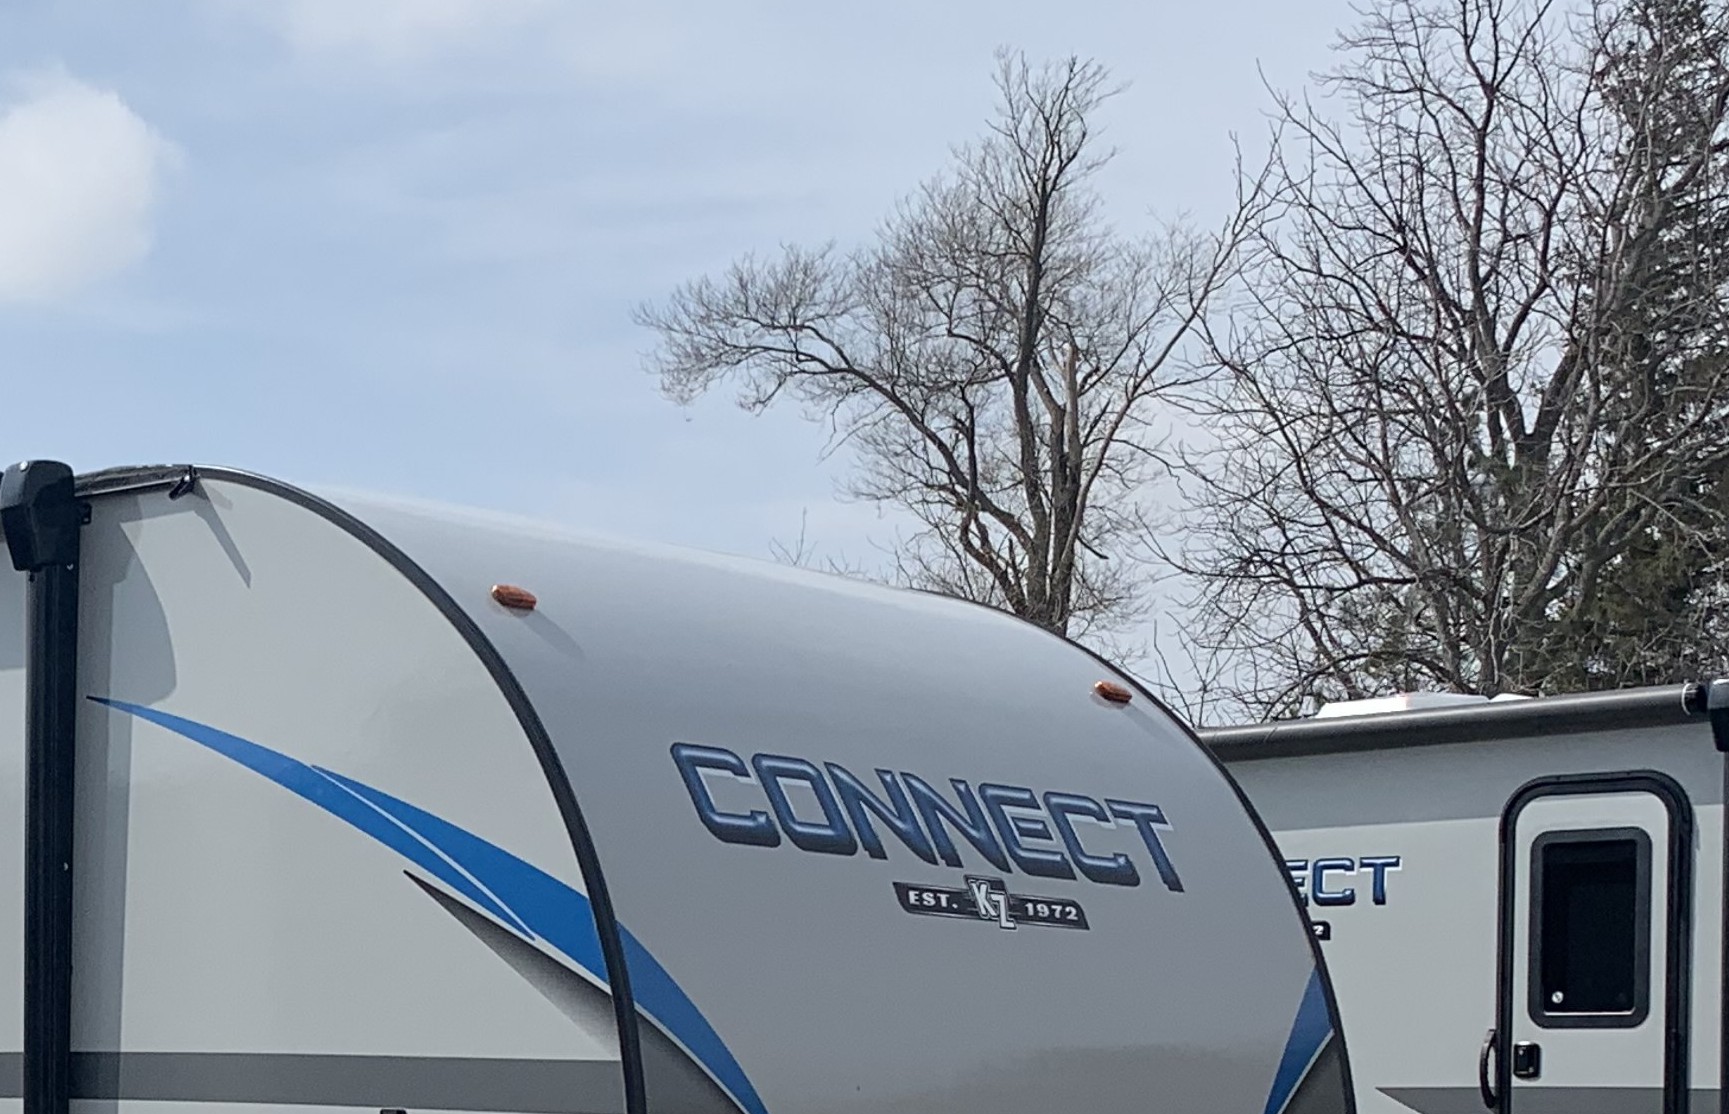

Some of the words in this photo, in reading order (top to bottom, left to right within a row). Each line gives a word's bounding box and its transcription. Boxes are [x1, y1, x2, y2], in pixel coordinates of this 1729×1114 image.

[670, 742, 1185, 892] CONNECT
[908, 890, 958, 909] EST.
[970, 879, 1015, 929] KZ
[1024, 902, 1079, 921] 1972
